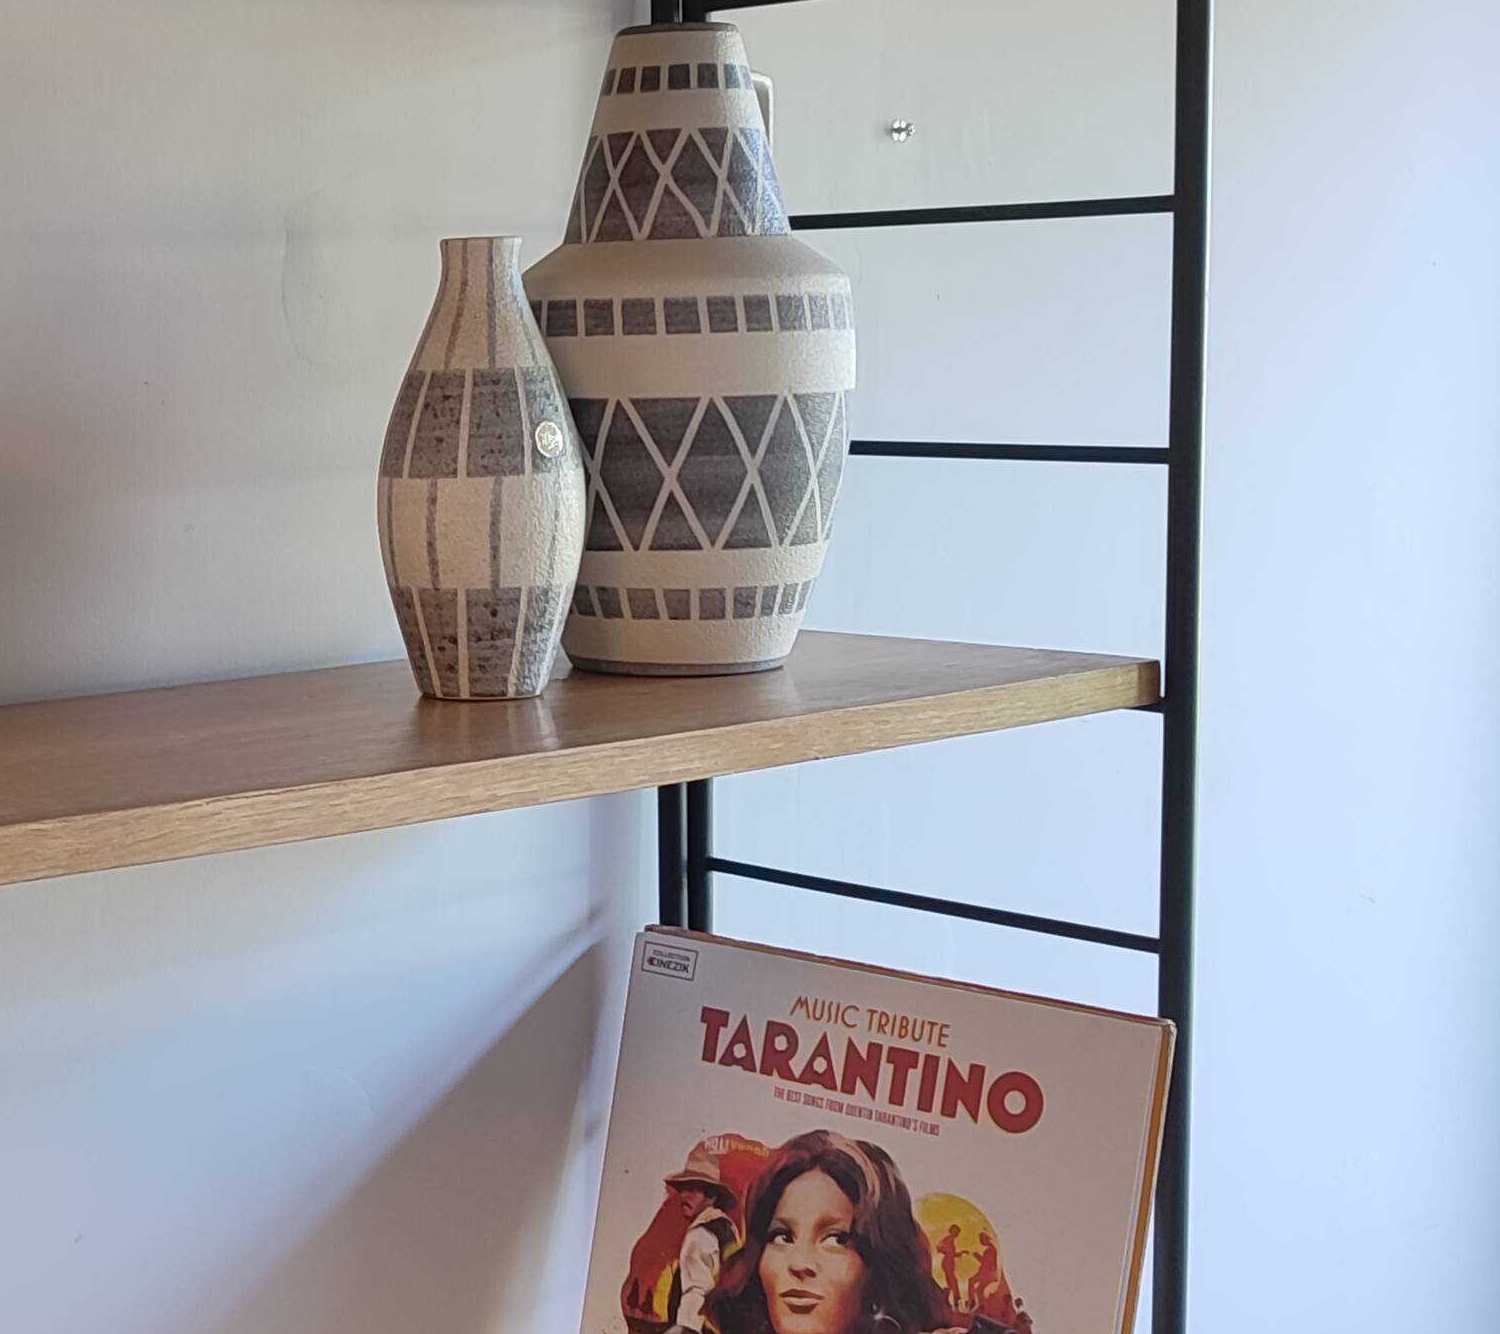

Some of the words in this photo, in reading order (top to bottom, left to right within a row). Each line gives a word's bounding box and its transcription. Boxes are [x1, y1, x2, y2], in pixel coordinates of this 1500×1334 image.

[789, 995, 859, 1029] MUSIC
[867, 1008, 950, 1047] TRIBUTE
[700, 1005, 1045, 1134] TARANTINO
